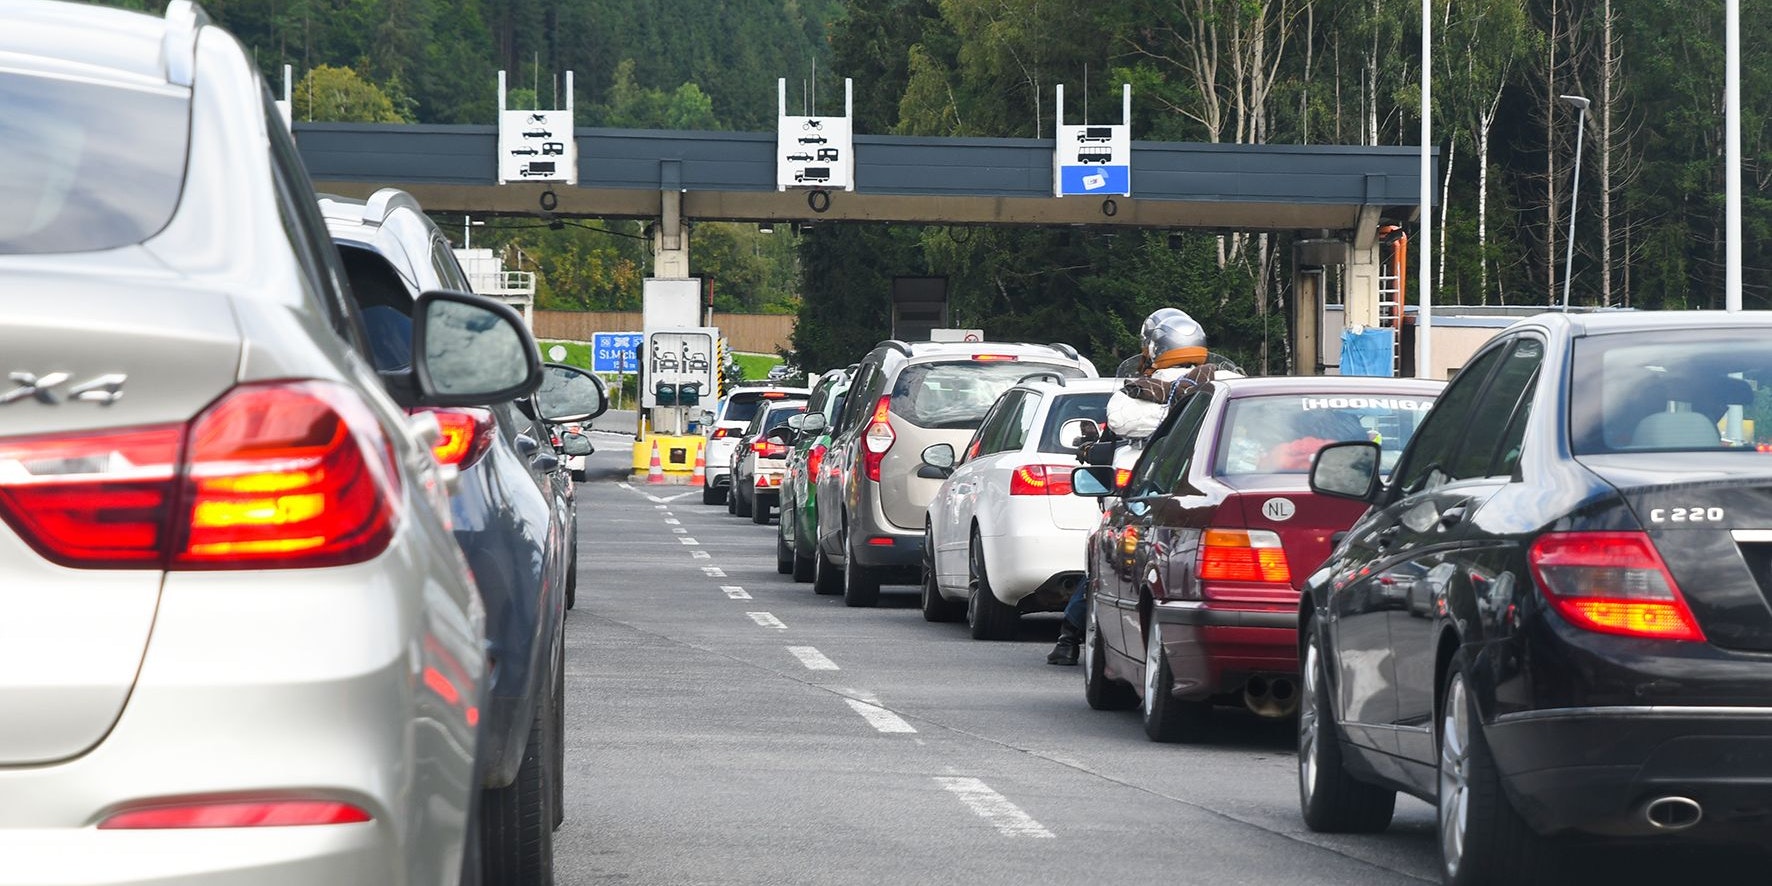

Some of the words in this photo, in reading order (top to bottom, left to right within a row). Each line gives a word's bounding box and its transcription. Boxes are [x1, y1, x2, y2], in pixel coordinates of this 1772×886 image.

[1268, 502, 1288, 516] NL
[1650, 508, 1665, 523] C
[1671, 507, 1724, 522] 220
